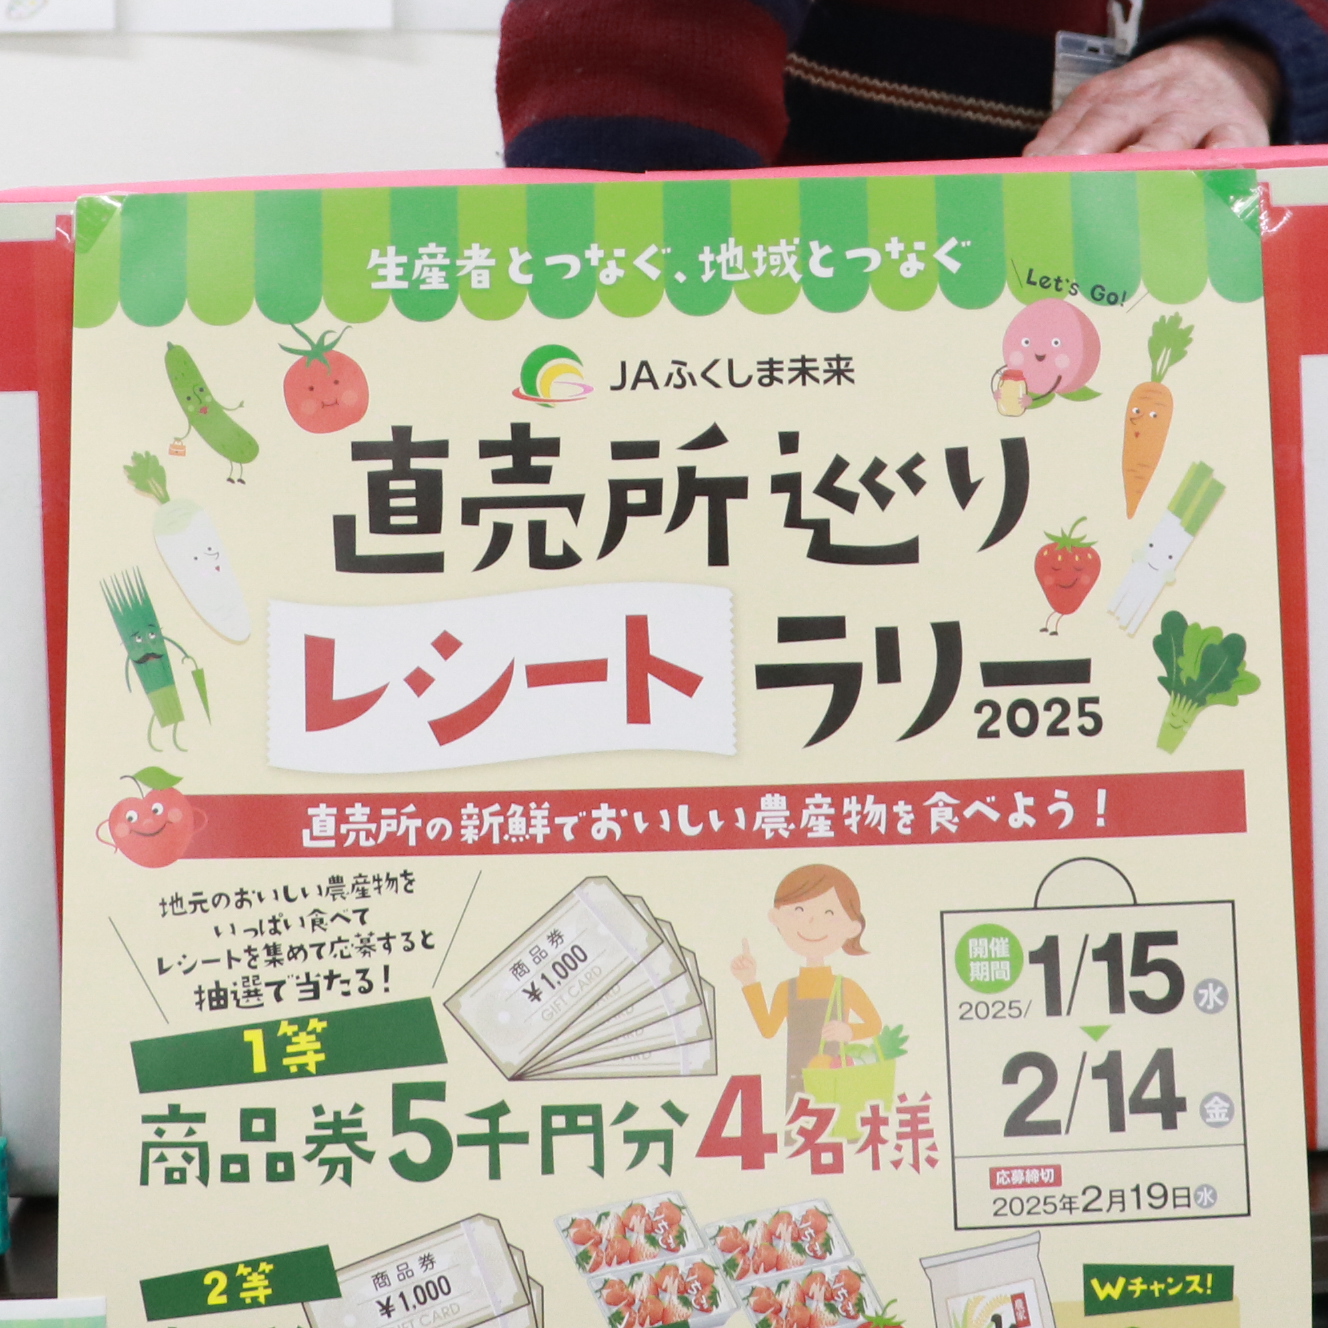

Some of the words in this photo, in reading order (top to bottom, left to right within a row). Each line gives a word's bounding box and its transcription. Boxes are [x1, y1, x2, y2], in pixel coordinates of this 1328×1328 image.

[367, 236, 972, 291] 生産者とつなぐ、地域とつなぐ
[1026, 267, 1080, 297] Let's
[1090, 282, 1129, 308] Go!
[609, 354, 855, 392] JAふくしま未来
[332, 420, 1031, 574] 直売所巡り
[974, 696, 1106, 740] 2025
[159, 869, 416, 918] 地元のおいしい農産物を
[213, 908, 369, 938] いっぱい食べて
[157, 930, 435, 976] レシートを集めて応募すると
[509, 928, 565, 981] 商品券
[968, 936, 1010, 959] 開催
[969, 960, 1012, 983] 期間
[1028, 929, 1186, 1017] 1/15
[243, 1018, 328, 1074] 1等
[1001, 1047, 1188, 1138] 2/14
[995, 1168, 1056, 1186] 応募締切
[992, 1182, 1192, 1218] 2025年2月19日
[203, 1261, 274, 1306] 2等
[371, 1252, 437, 1292] 商品券
